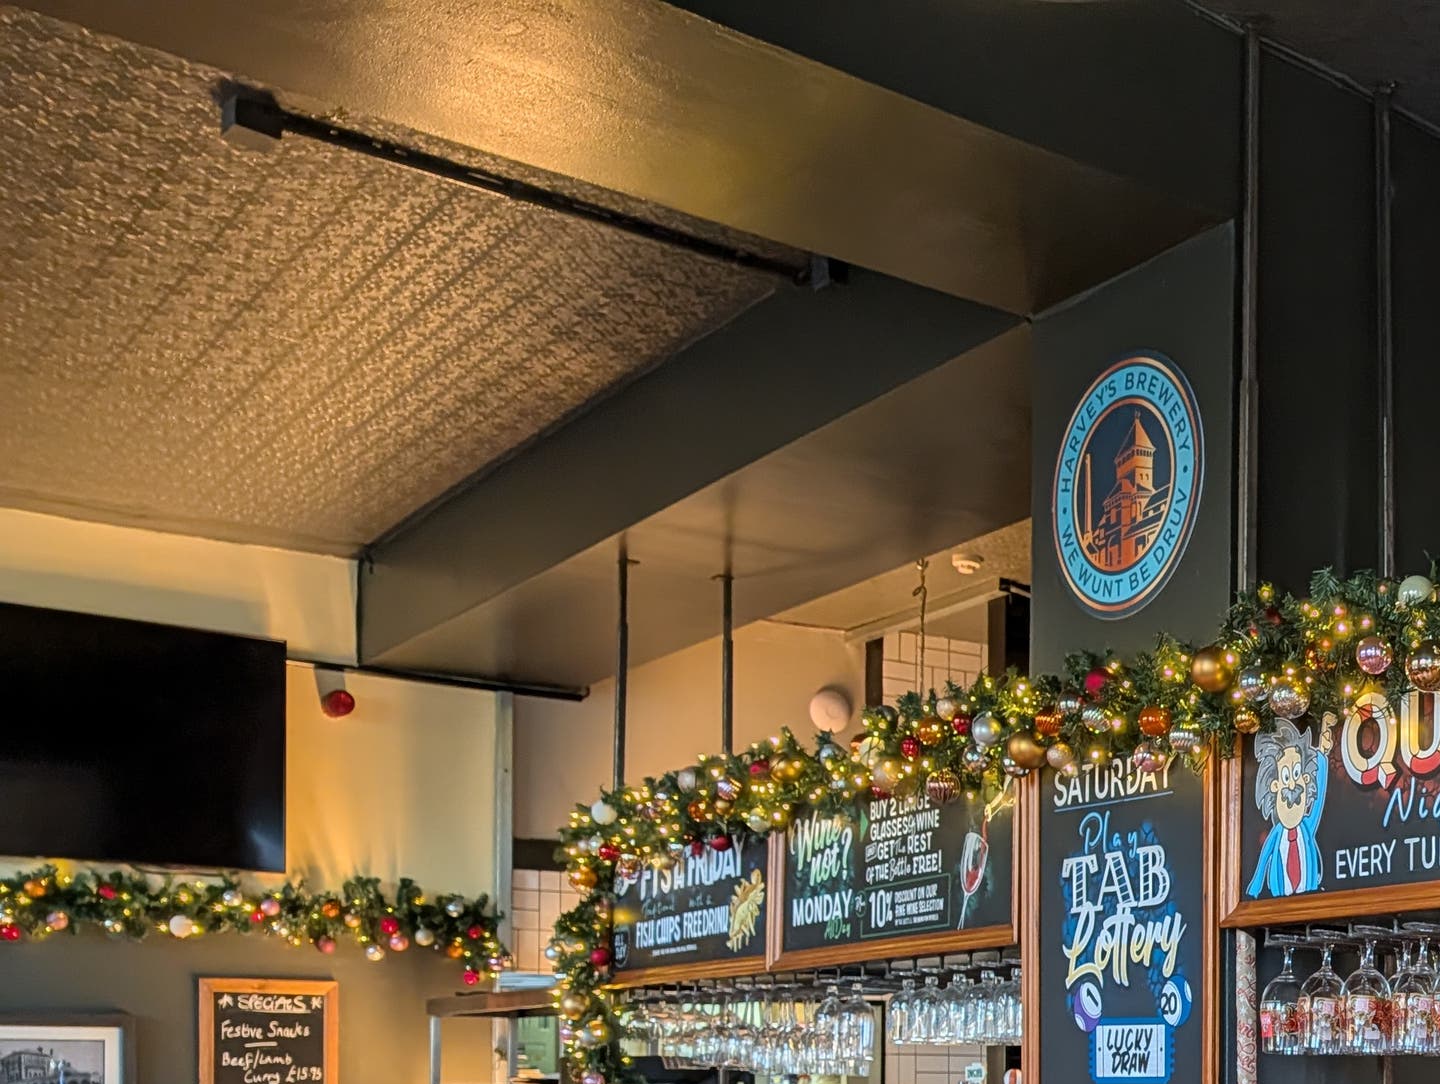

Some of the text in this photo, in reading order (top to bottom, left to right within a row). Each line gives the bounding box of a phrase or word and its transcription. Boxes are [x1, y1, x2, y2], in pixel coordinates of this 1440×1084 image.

[1061, 371, 1190, 493] HARVEY'S BREWERY
[1061, 487, 1188, 598] WE WUNT BE DRUV
[1053, 752, 1177, 807] SATURDAY
[870, 800, 888, 821] BUY
[889, 798, 897, 816] 2
[870, 816, 908, 842] GLASSES
[916, 809, 940, 831] WINE
[790, 809, 842, 871] Wine
[877, 842, 894, 861] GET
[907, 832, 933, 855] REST
[1079, 810, 1139, 859] Play
[912, 849, 943, 876] FREE!
[1335, 840, 1397, 880] EVERY
[1062, 844, 1171, 914] TAB
[792, 888, 853, 928] MONDAY
[869, 889, 893, 929] 10%
[237, 994, 306, 1011] SPECIALS
[1160, 991, 1177, 1015] 20
[221, 1019, 263, 1039] Festive
[1106, 1027, 1153, 1052] LUCKY
[1110, 1050, 1150, 1076] DRAW
